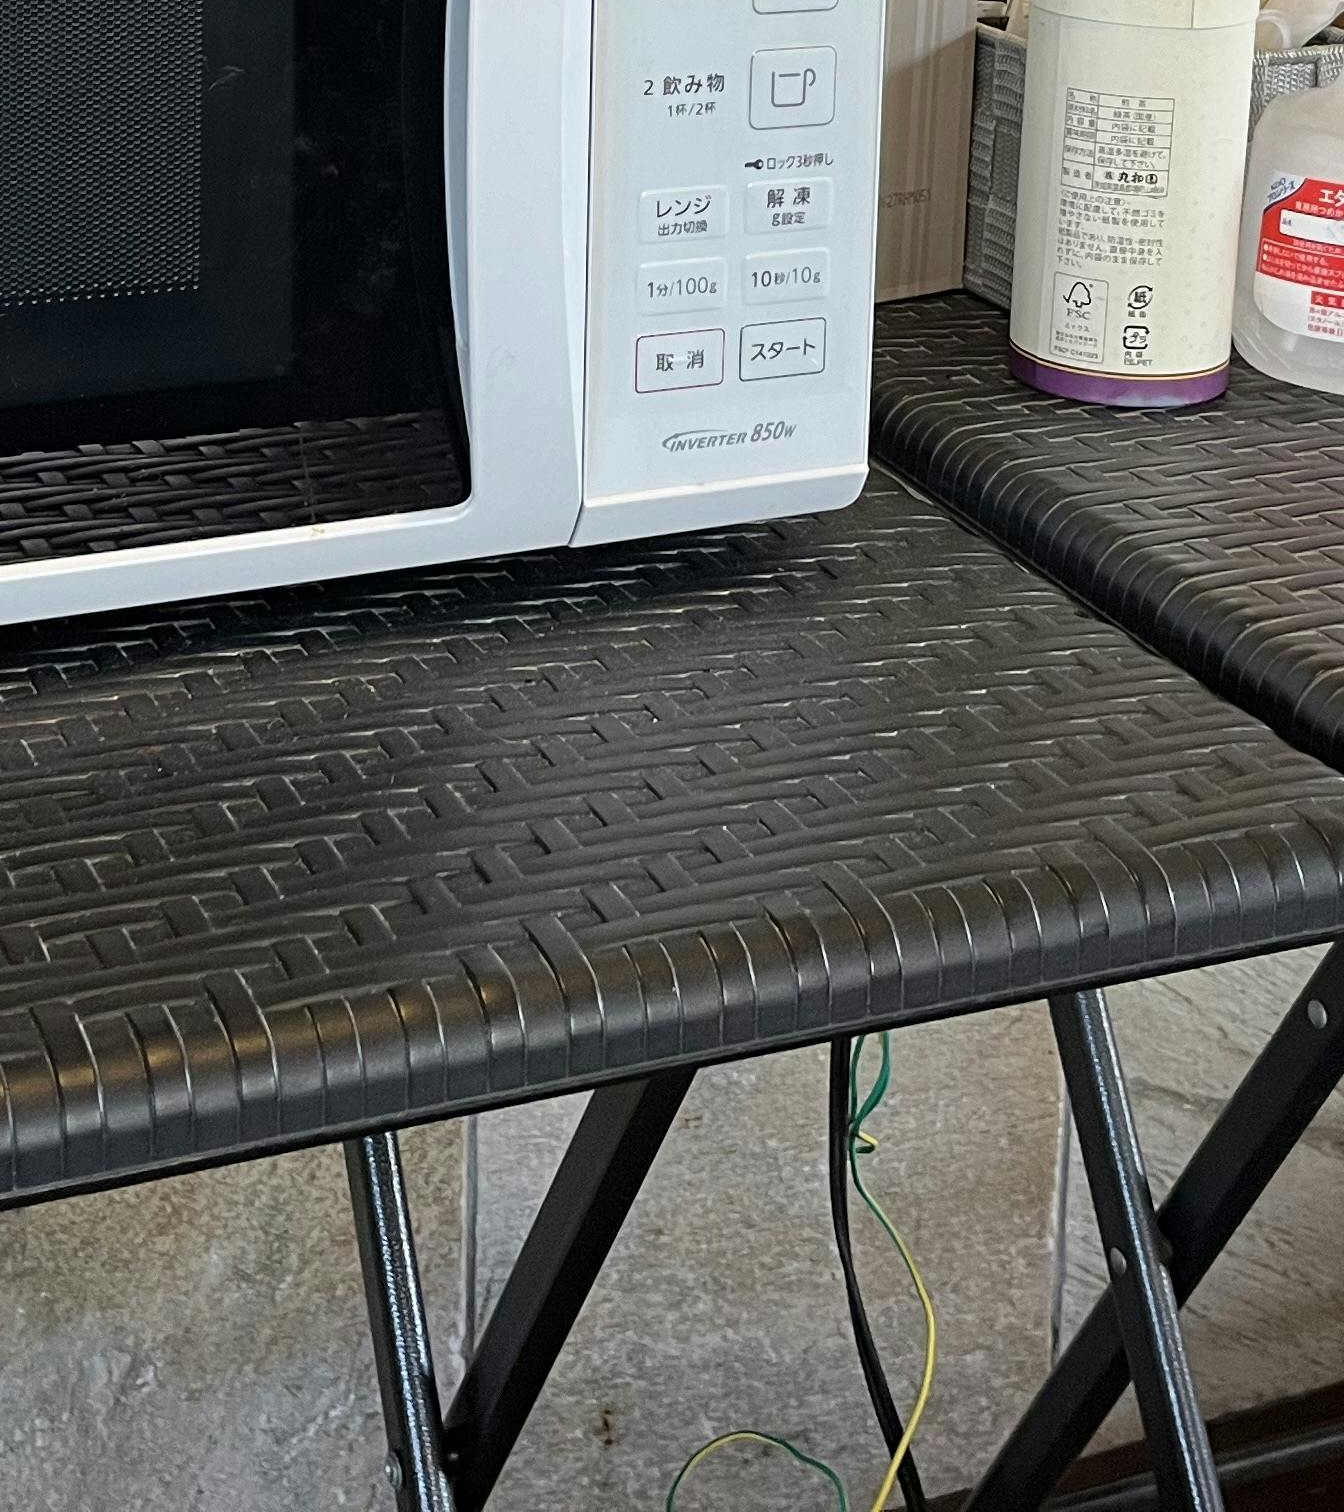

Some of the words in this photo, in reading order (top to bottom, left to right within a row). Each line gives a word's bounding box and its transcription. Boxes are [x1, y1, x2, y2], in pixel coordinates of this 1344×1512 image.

[662, 73, 725, 96] 飲み物
[766, 152, 834, 171] ロック3秒押し
[656, 194, 712, 218] レンジ
[767, 187, 811, 209] 解凍
[647, 275, 717, 298] 1分/100g
[751, 266, 821, 288] 10秒/10g
[656, 349, 705, 372] 取消
[750, 337, 816, 362] スタート
[664, 429, 747, 453] INVERTER
[750, 420, 797, 443] 850W
